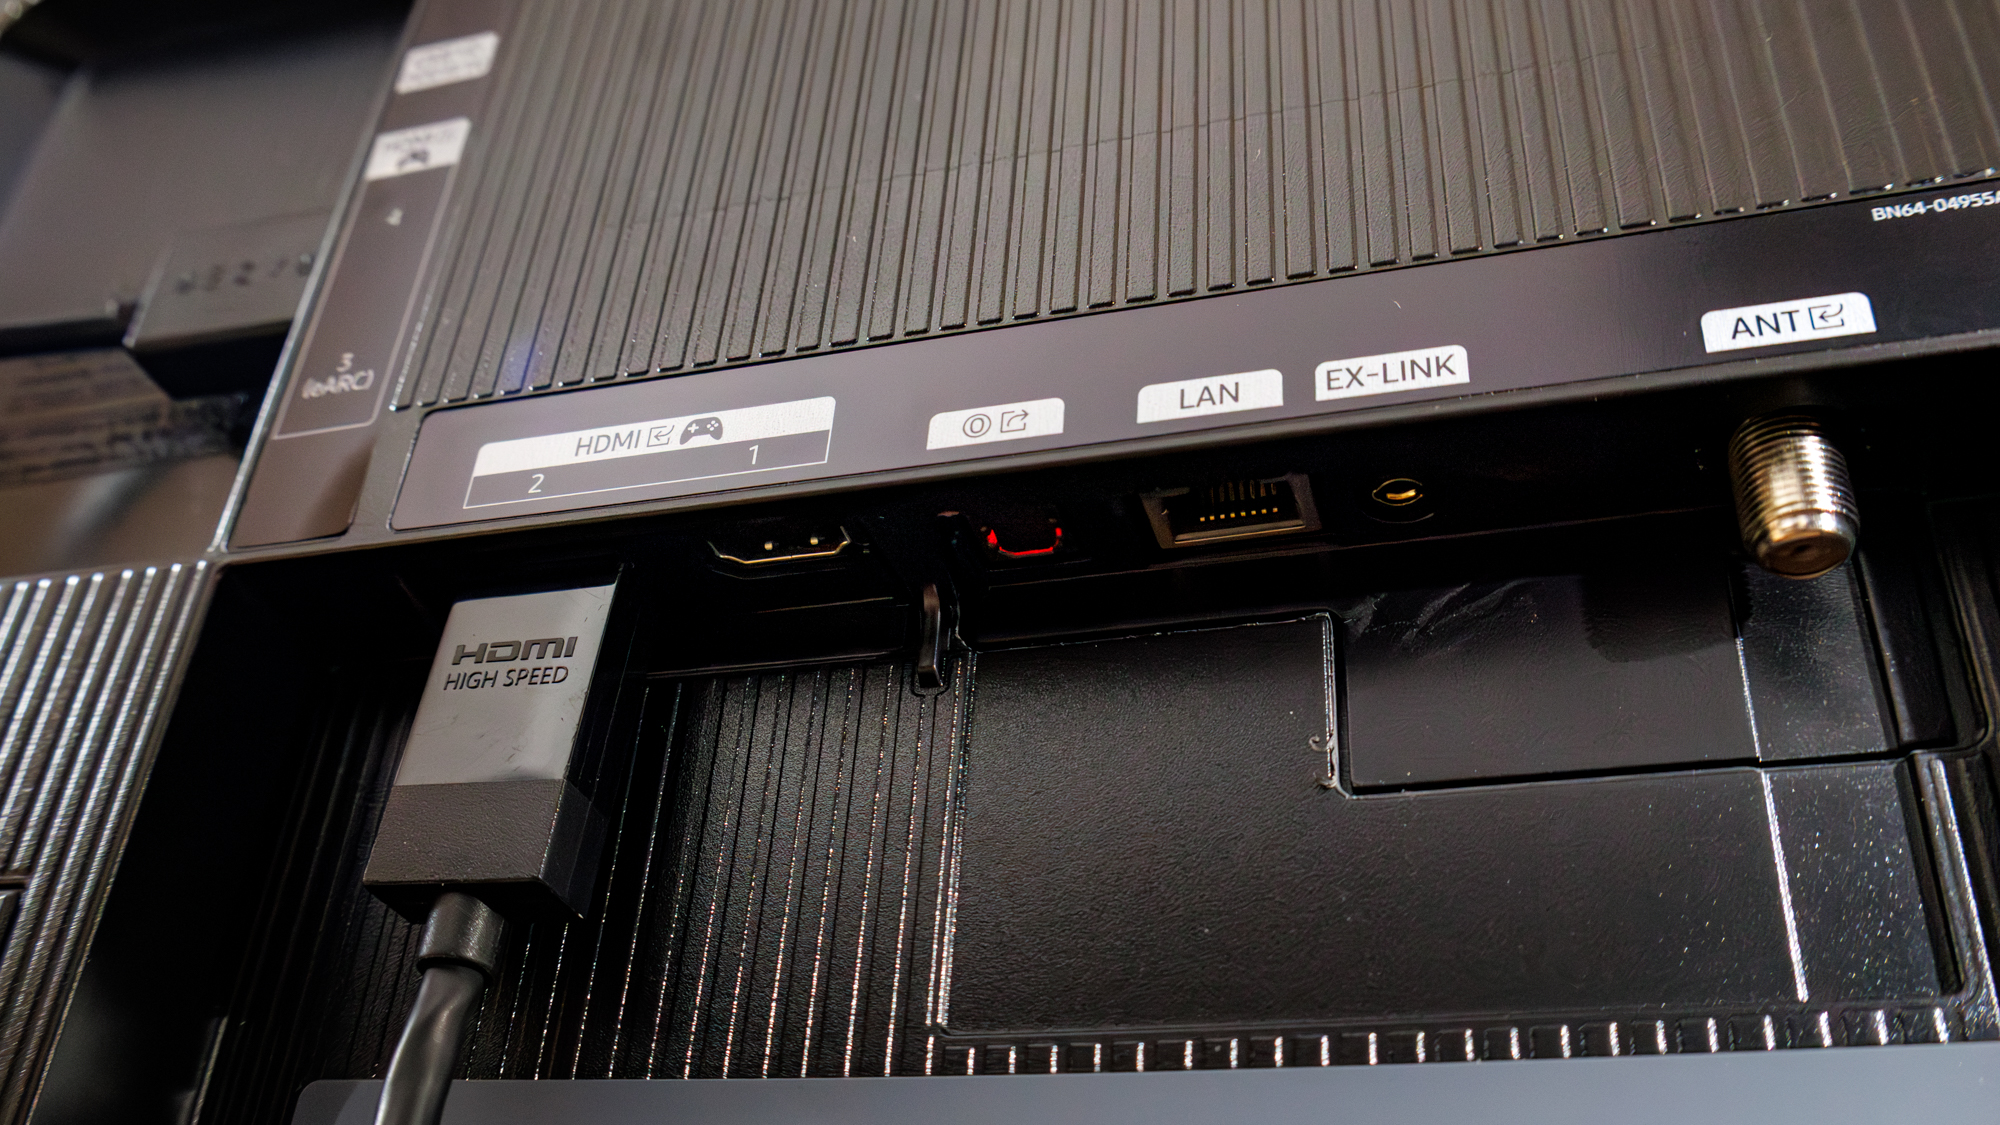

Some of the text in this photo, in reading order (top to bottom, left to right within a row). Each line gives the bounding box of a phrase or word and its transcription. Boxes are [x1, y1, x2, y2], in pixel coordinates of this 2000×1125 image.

[1732, 310, 1800, 340] ANT
[1327, 354, 1456, 391] EX-LINK
[1180, 382, 1239, 409] LAN
[575, 429, 641, 457] HDMI
[749, 445, 759, 465] 1
[528, 474, 545, 493] 2
[452, 636, 578, 665] HDMI
[444, 666, 569, 690] HIGH SPEED
